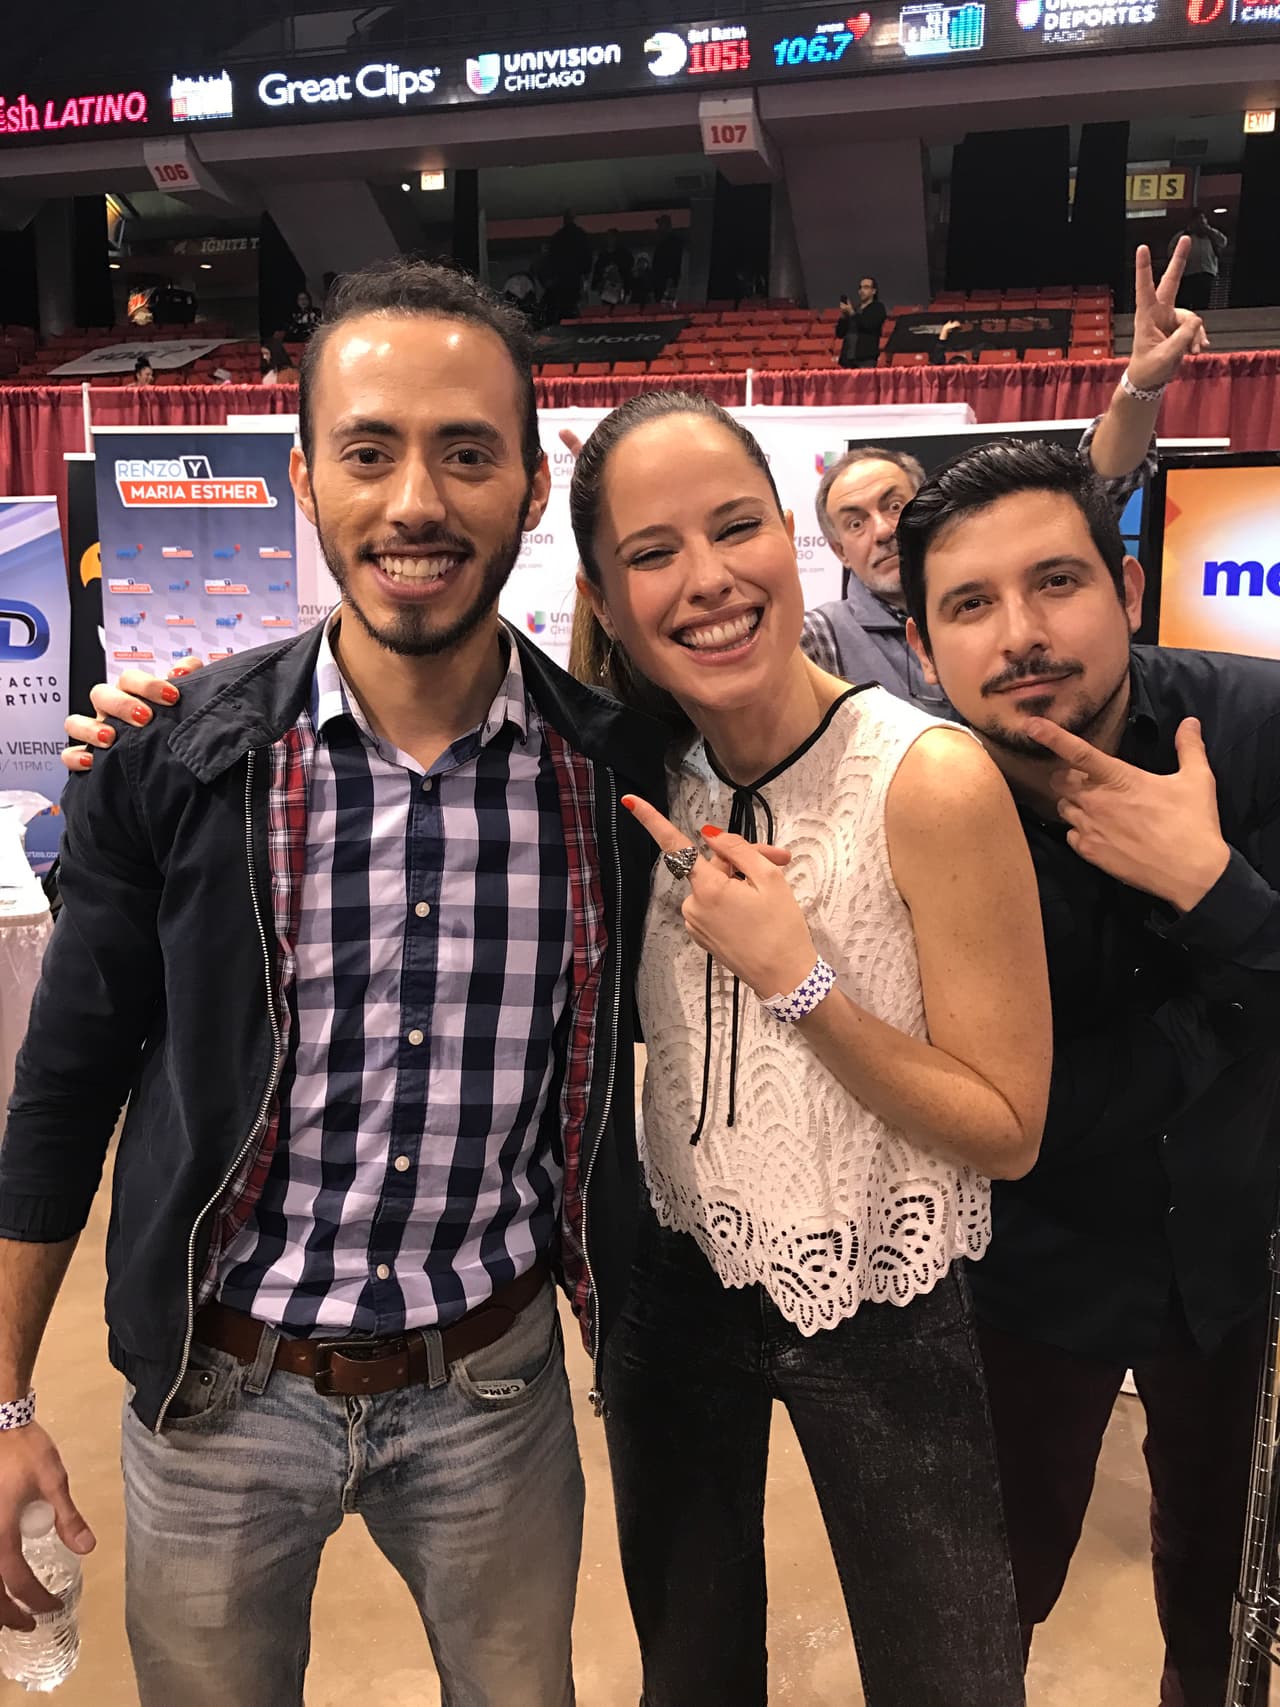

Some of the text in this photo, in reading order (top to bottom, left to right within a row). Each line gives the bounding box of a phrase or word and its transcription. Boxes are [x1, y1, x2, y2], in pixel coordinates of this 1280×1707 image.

[1044, 5, 1158, 31] DEPORTES
[774, 32, 853, 66] 106.7
[504, 44, 621, 73] UNIVISION
[258, 63, 436, 106] Great Clips
[504, 69, 585, 91] CHICAGO
[1247, 111, 1271, 129] EXIT
[711, 124, 747, 144] 107
[154, 164, 189, 182] 106
[201, 239, 248, 253] IGNITE
[117, 461, 202, 478] RENZO Y
[131, 484, 257, 499] MARIA ESTHER
[0, 676, 58, 688] ACTO
[5, 692, 62, 706] RTIVO
